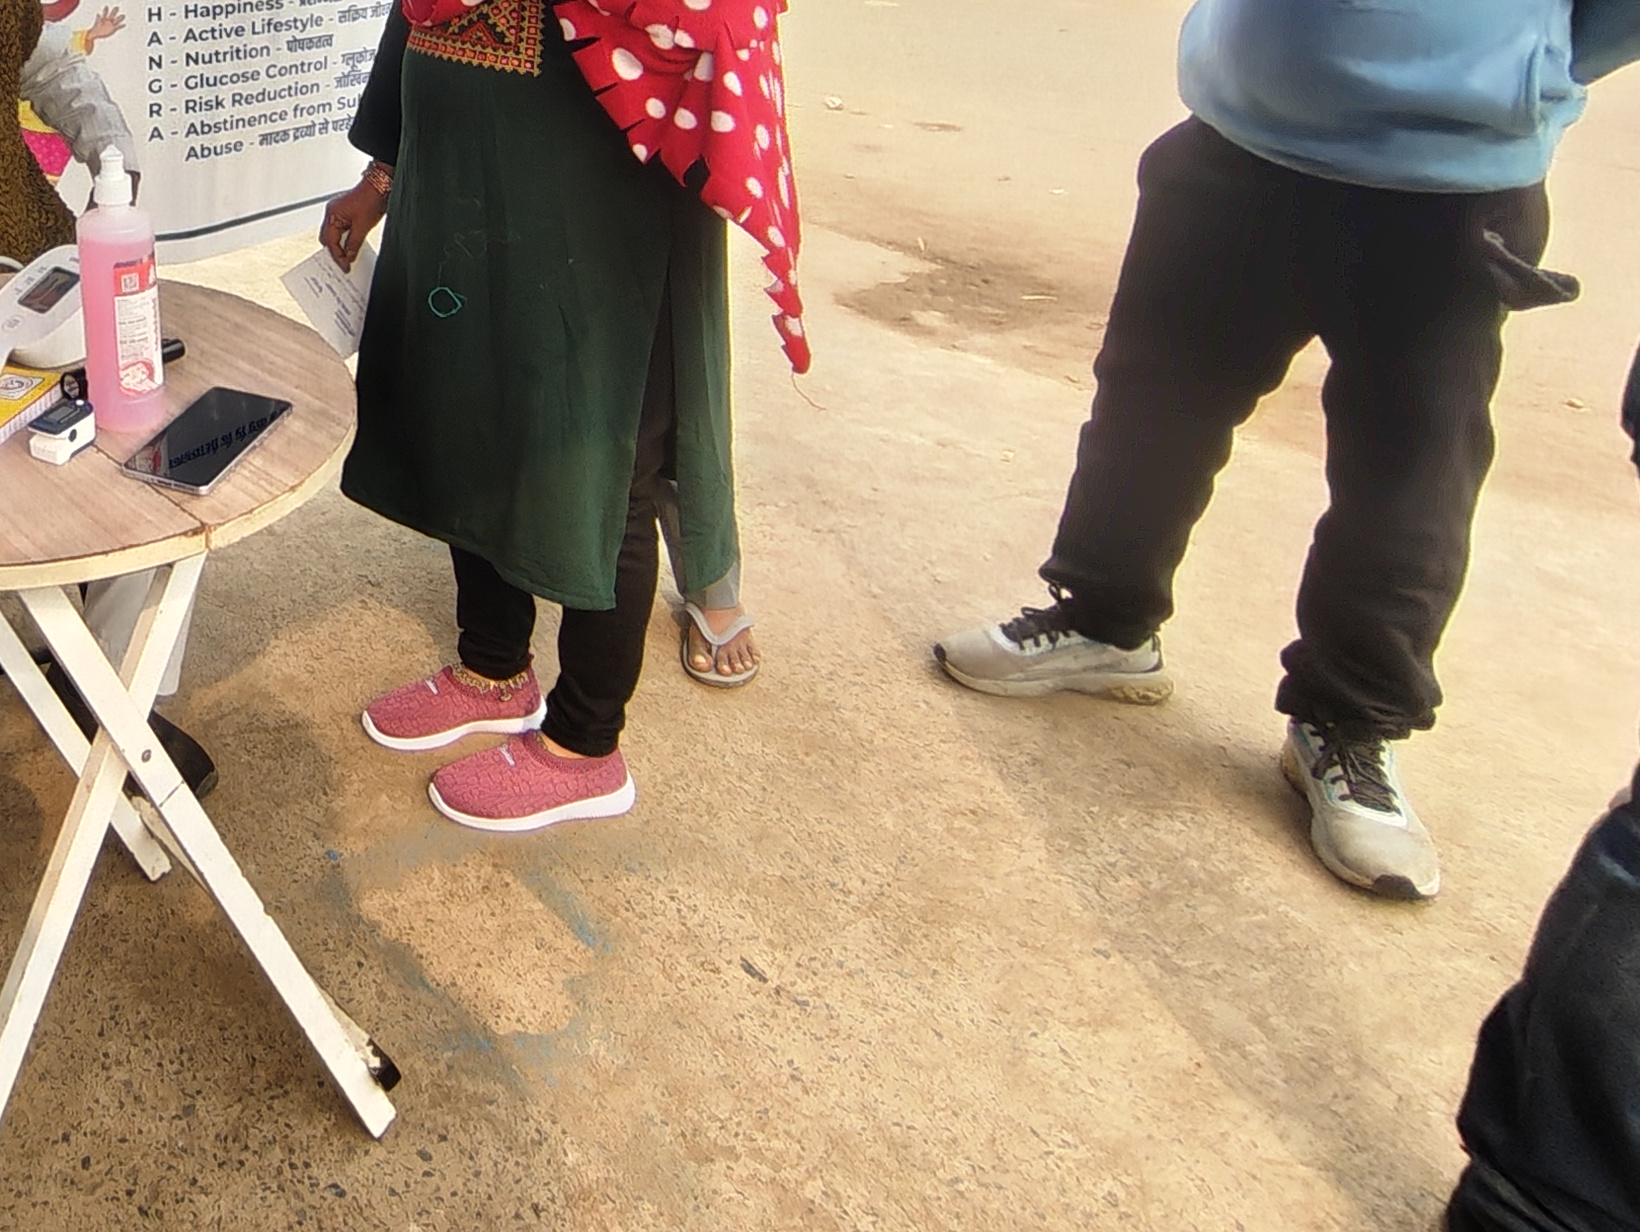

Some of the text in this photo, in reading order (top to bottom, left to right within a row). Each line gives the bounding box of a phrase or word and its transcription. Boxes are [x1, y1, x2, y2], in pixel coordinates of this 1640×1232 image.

[147, 12, 324, 47] A Active Lifestyle
[148, 7, 162, 22] H
[148, 43, 271, 70] N Nutrition
[148, 79, 162, 94] G
[184, 70, 260, 91] Glucose
[265, 56, 328, 79] Control
[149, 103, 162, 118] R
[184, 95, 226, 115] Risk
[231, 80, 320, 108] Reduction
[148, 102, 332, 142] A Abstinence from
[185, 140, 244, 162] Abuse
